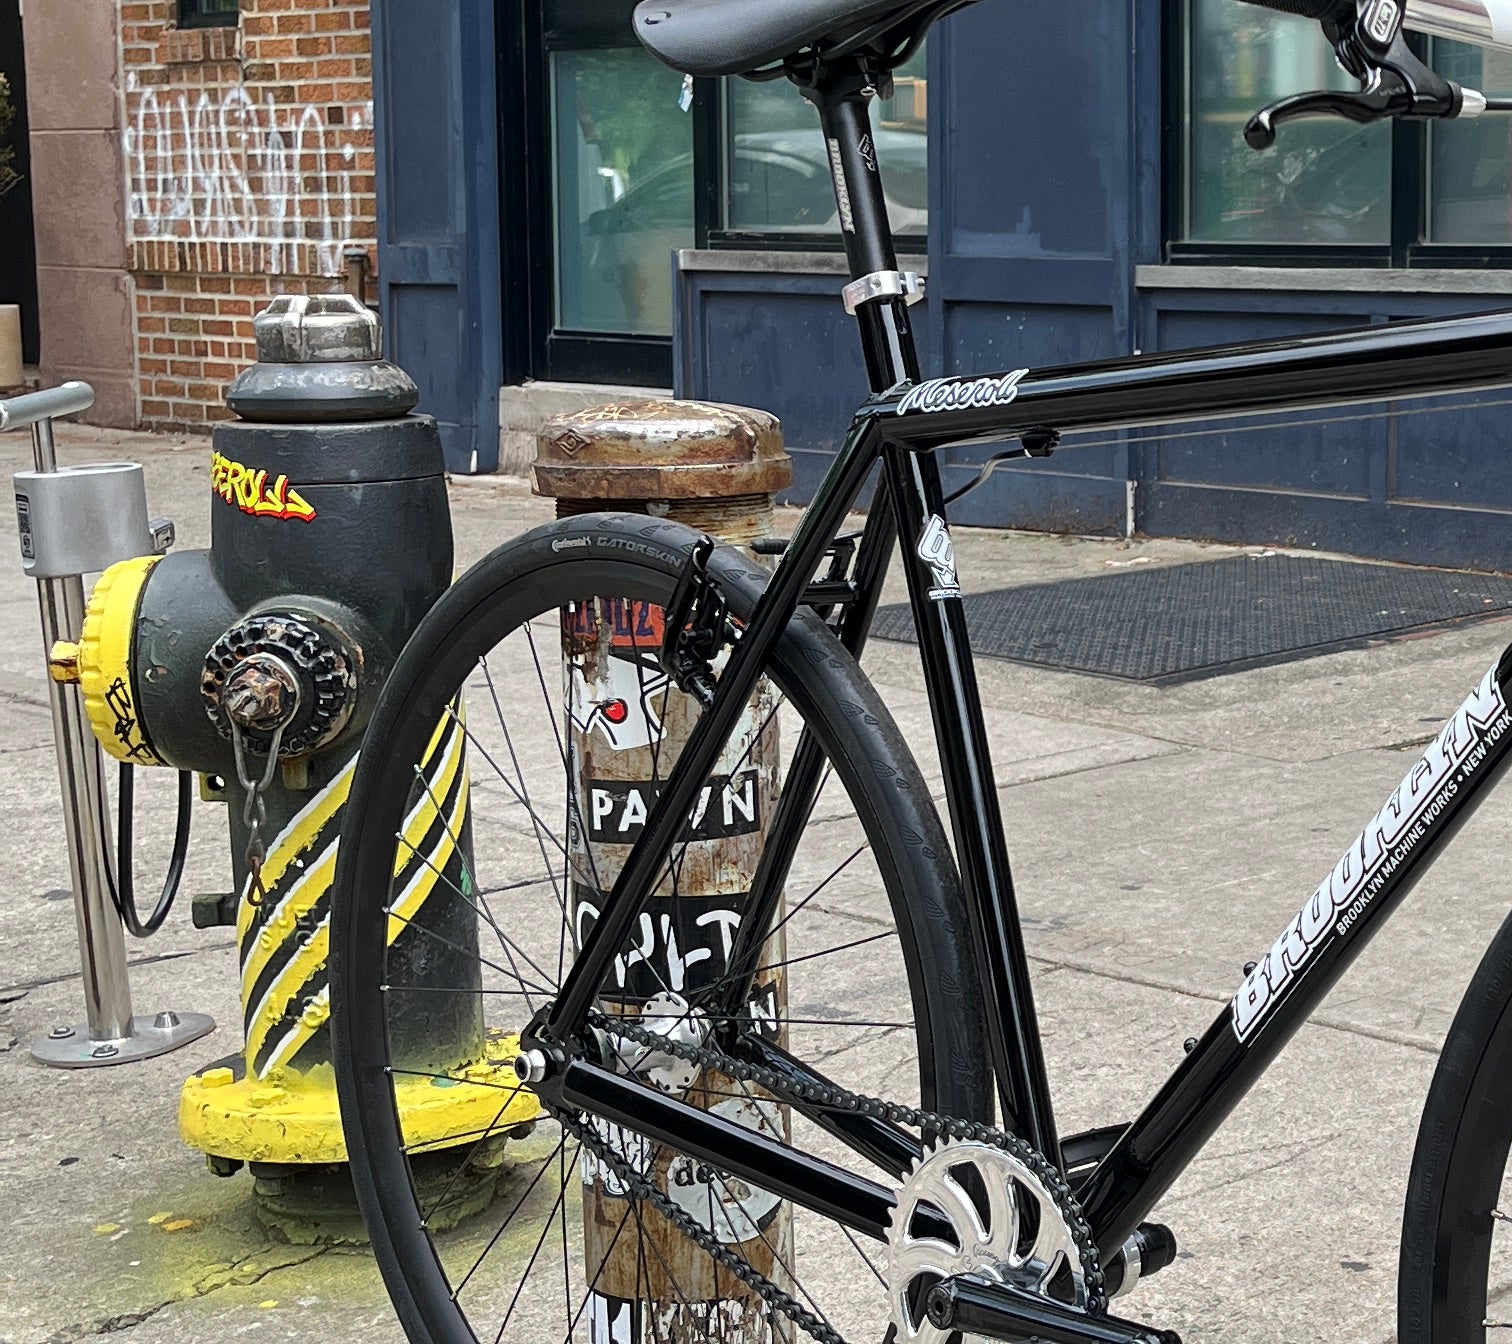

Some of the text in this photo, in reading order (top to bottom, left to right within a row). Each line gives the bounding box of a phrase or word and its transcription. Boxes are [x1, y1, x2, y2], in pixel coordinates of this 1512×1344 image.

[596, 537, 682, 567] GATORSKIN
[1336, 875, 1386, 936] BROOKLYN
[1384, 821, 1427, 879] MACHINE
[1421, 780, 1459, 827] WORKS
[1462, 749, 1488, 777] NEW
